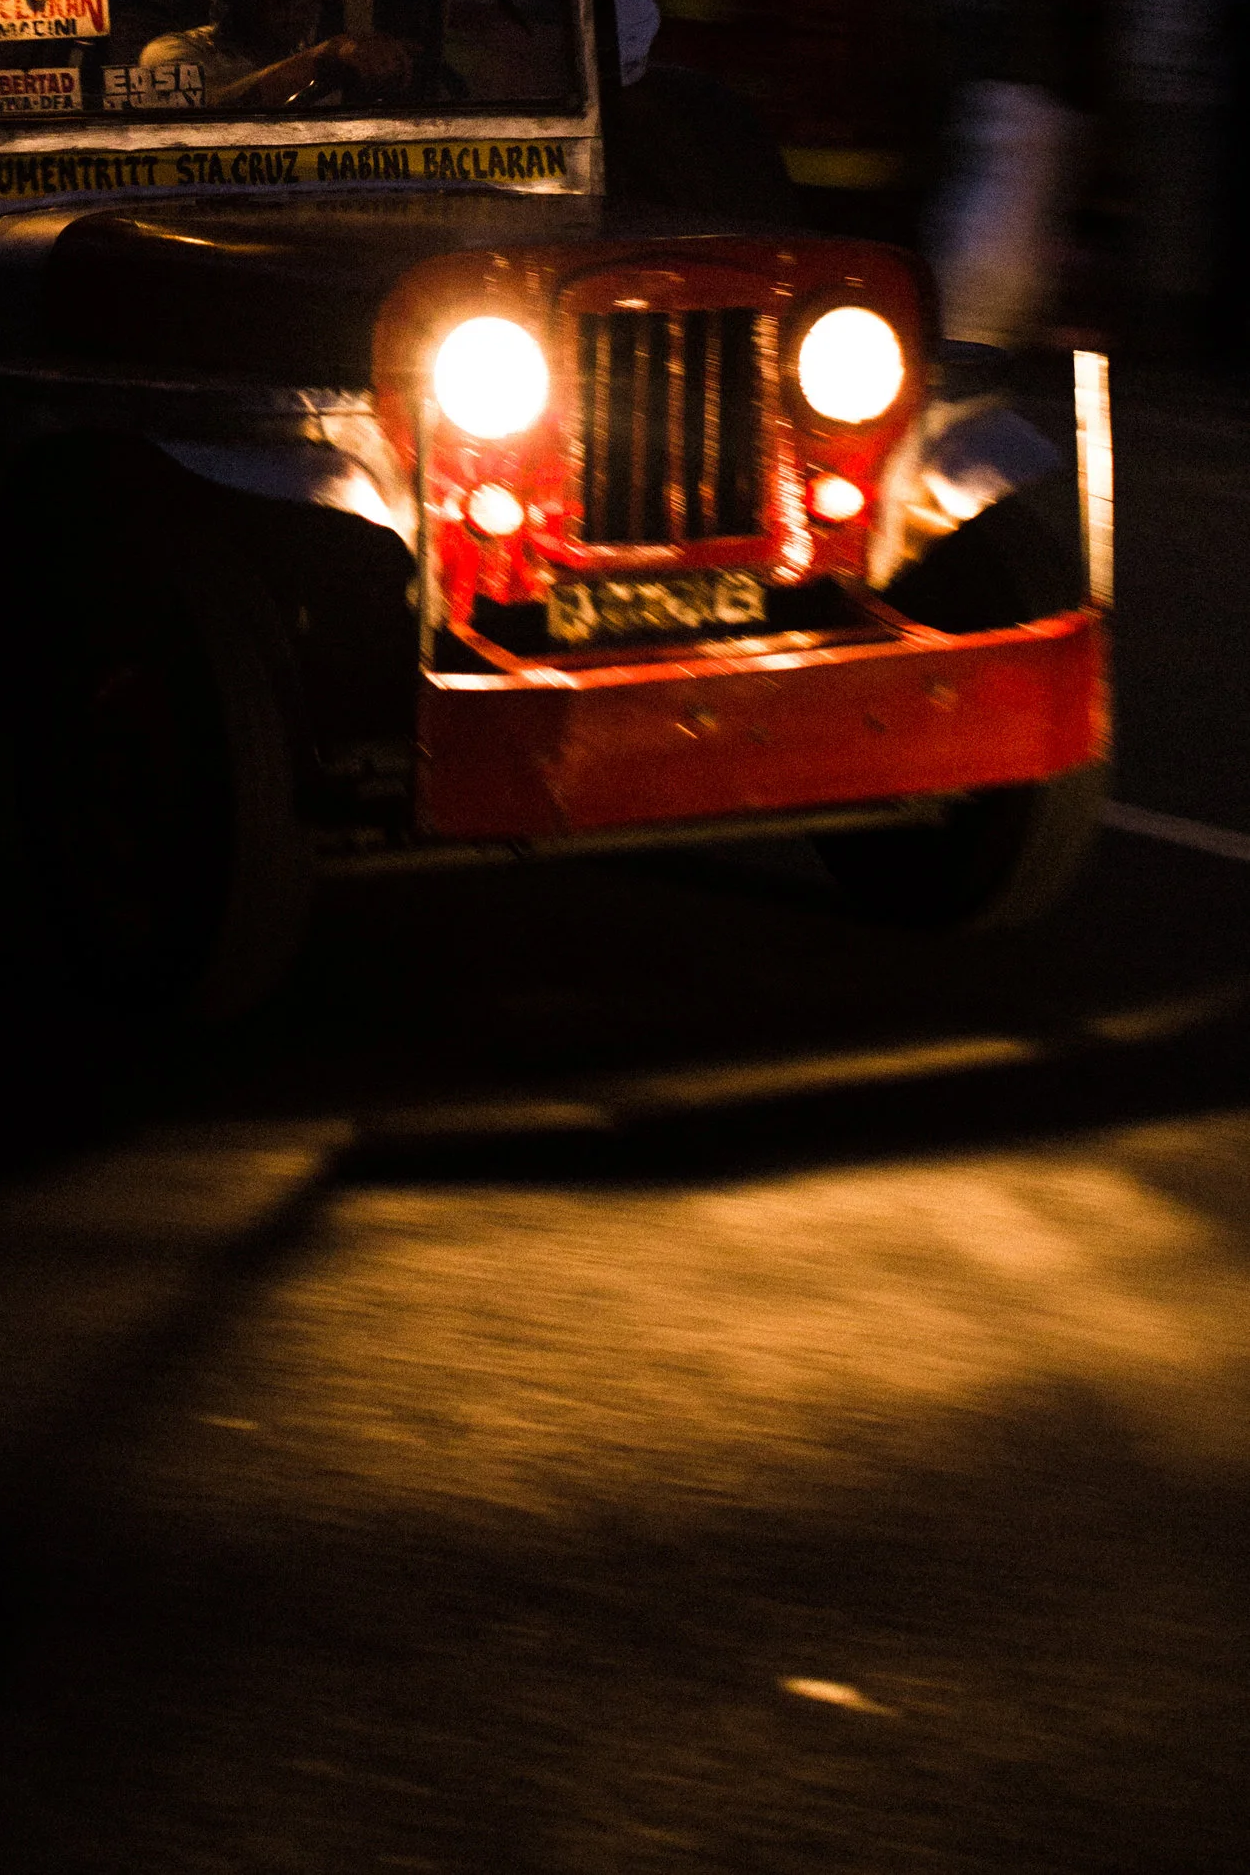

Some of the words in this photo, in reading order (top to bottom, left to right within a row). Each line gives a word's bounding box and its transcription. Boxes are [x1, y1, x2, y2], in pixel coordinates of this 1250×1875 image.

[103, 63, 203, 94] EDSA
[317, 148, 410, 182] MABINI
[423, 143, 567, 181] BACLARAN
